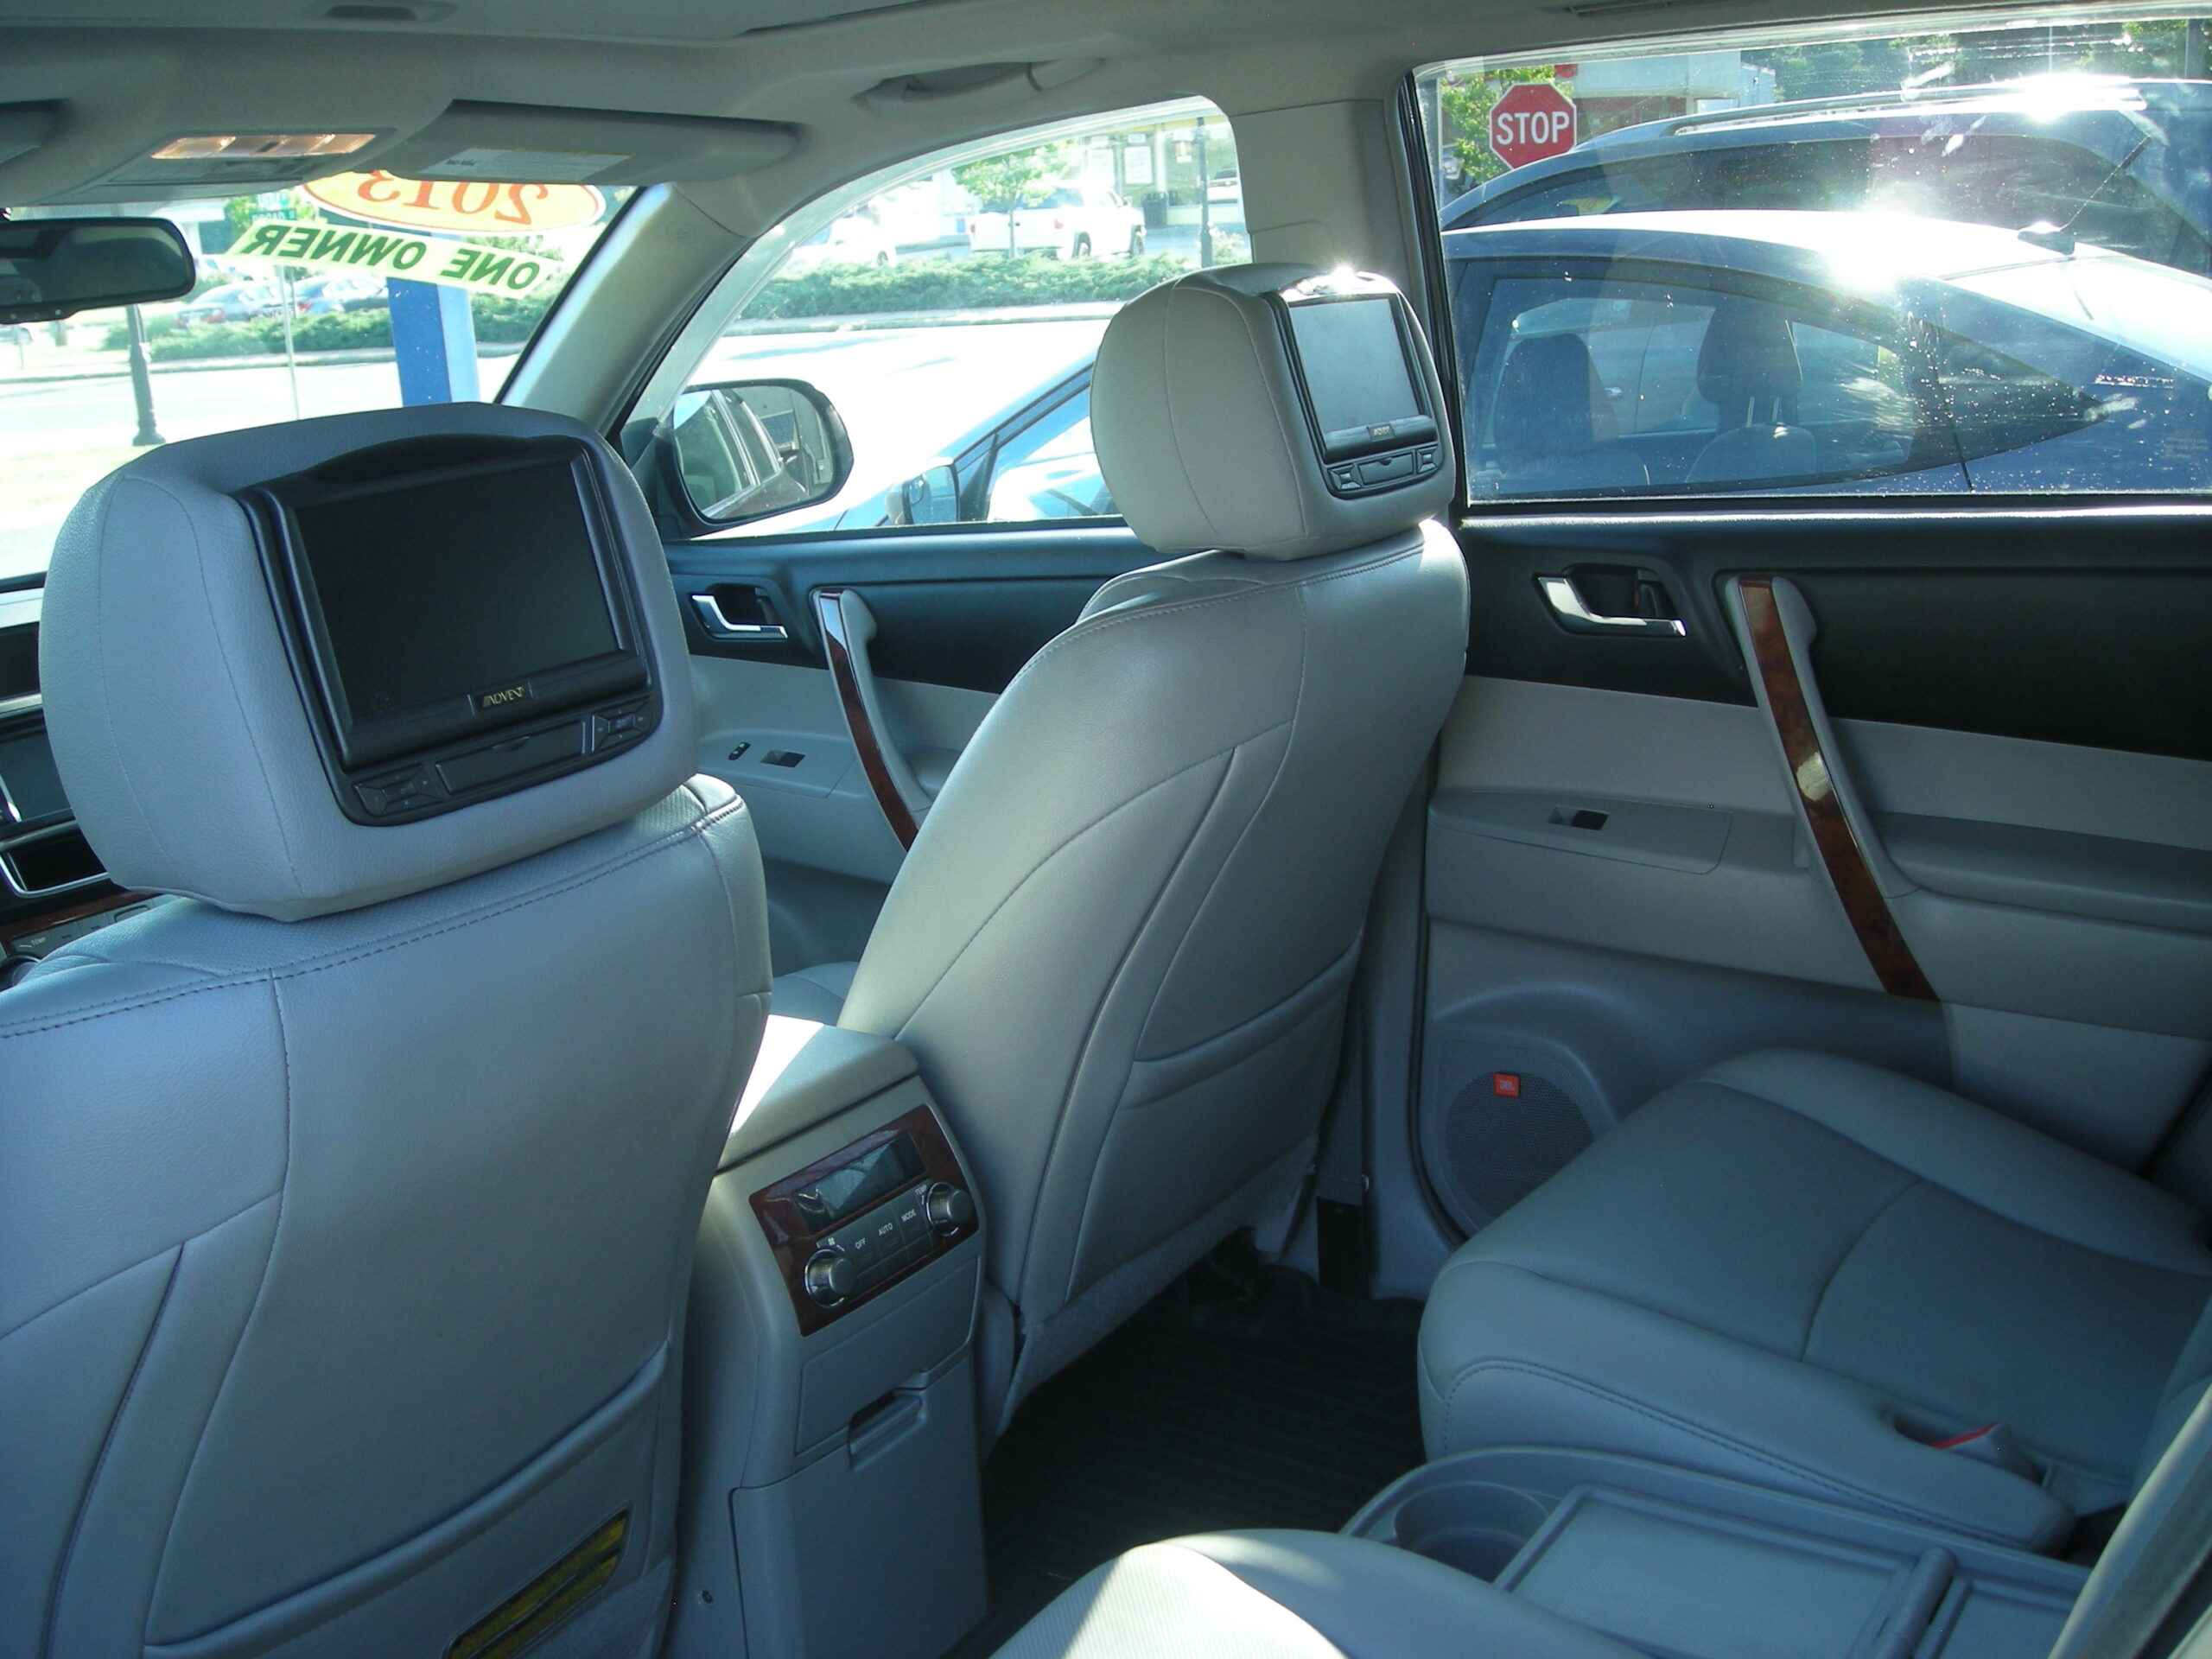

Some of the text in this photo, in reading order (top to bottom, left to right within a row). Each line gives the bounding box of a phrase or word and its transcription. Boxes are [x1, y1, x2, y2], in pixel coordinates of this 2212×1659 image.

[1496, 111, 1571, 145] STOP
[483, 687, 524, 708] ADVENT
[915, 1184, 927, 1195] TEMP
[855, 1209, 917, 1249] OFF AUTO MODE
